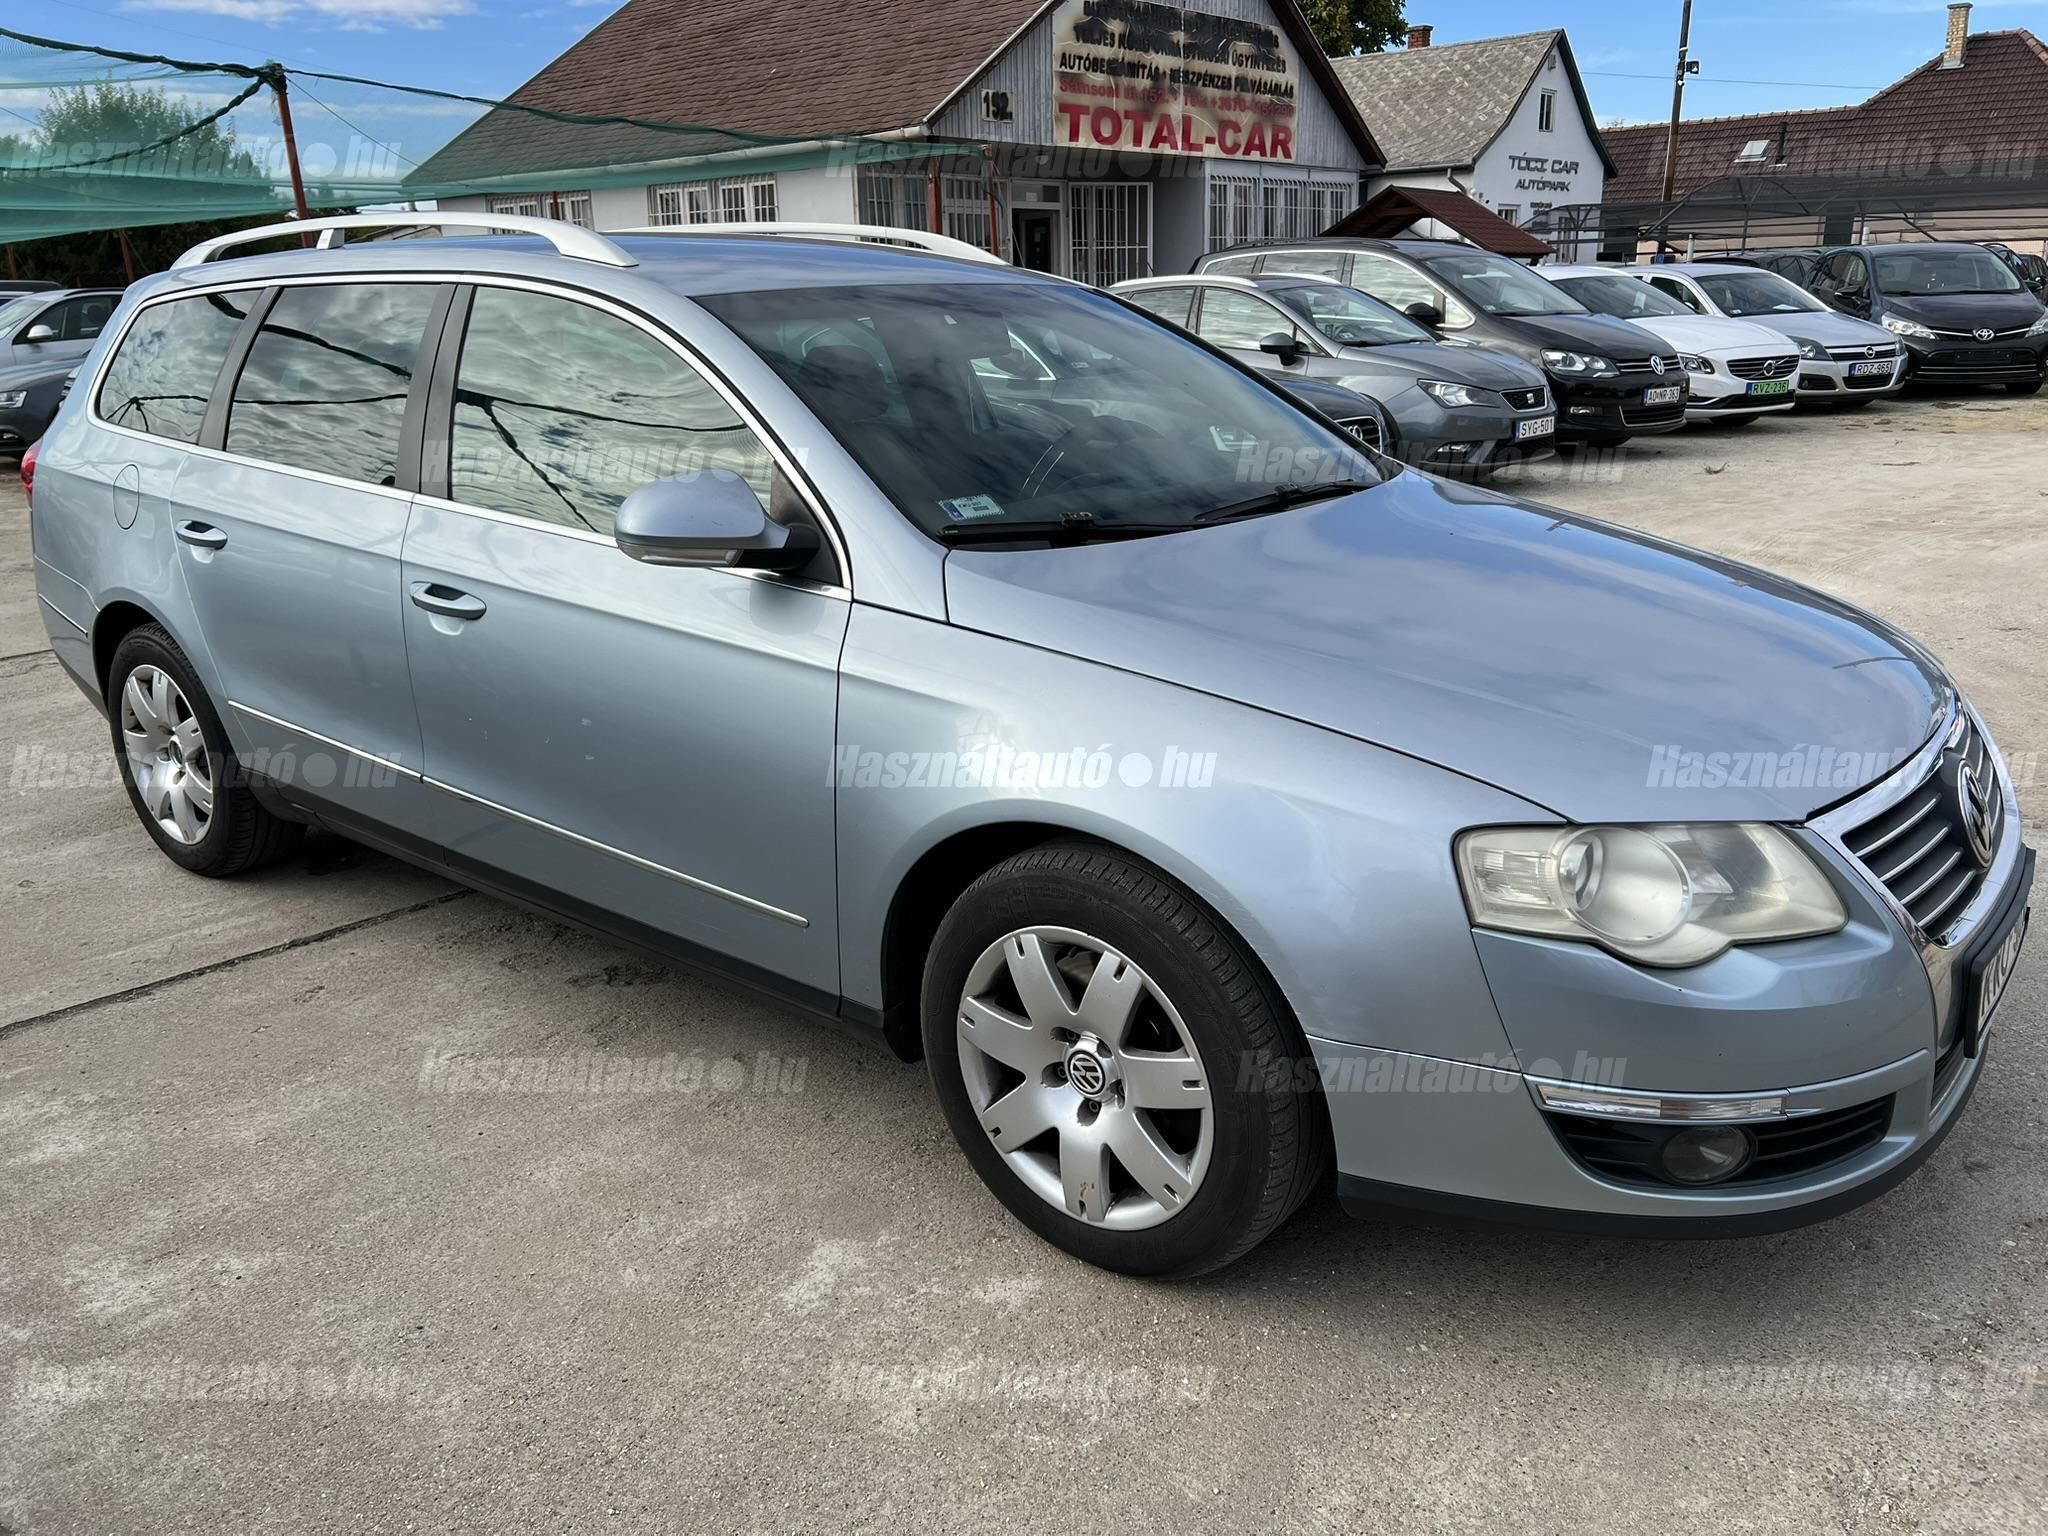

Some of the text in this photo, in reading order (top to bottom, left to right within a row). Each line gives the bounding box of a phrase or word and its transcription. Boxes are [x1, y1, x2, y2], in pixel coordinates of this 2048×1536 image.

[1058, 103, 1293, 160] TOTAL-CAR
[1551, 160, 1579, 175] CAR
[1515, 176, 1571, 193] AUTÓPARK
[1856, 363, 1891, 376] RDZ-965
[1752, 382, 1787, 396] RVZ-236
[1521, 417, 1553, 437] SYG-501
